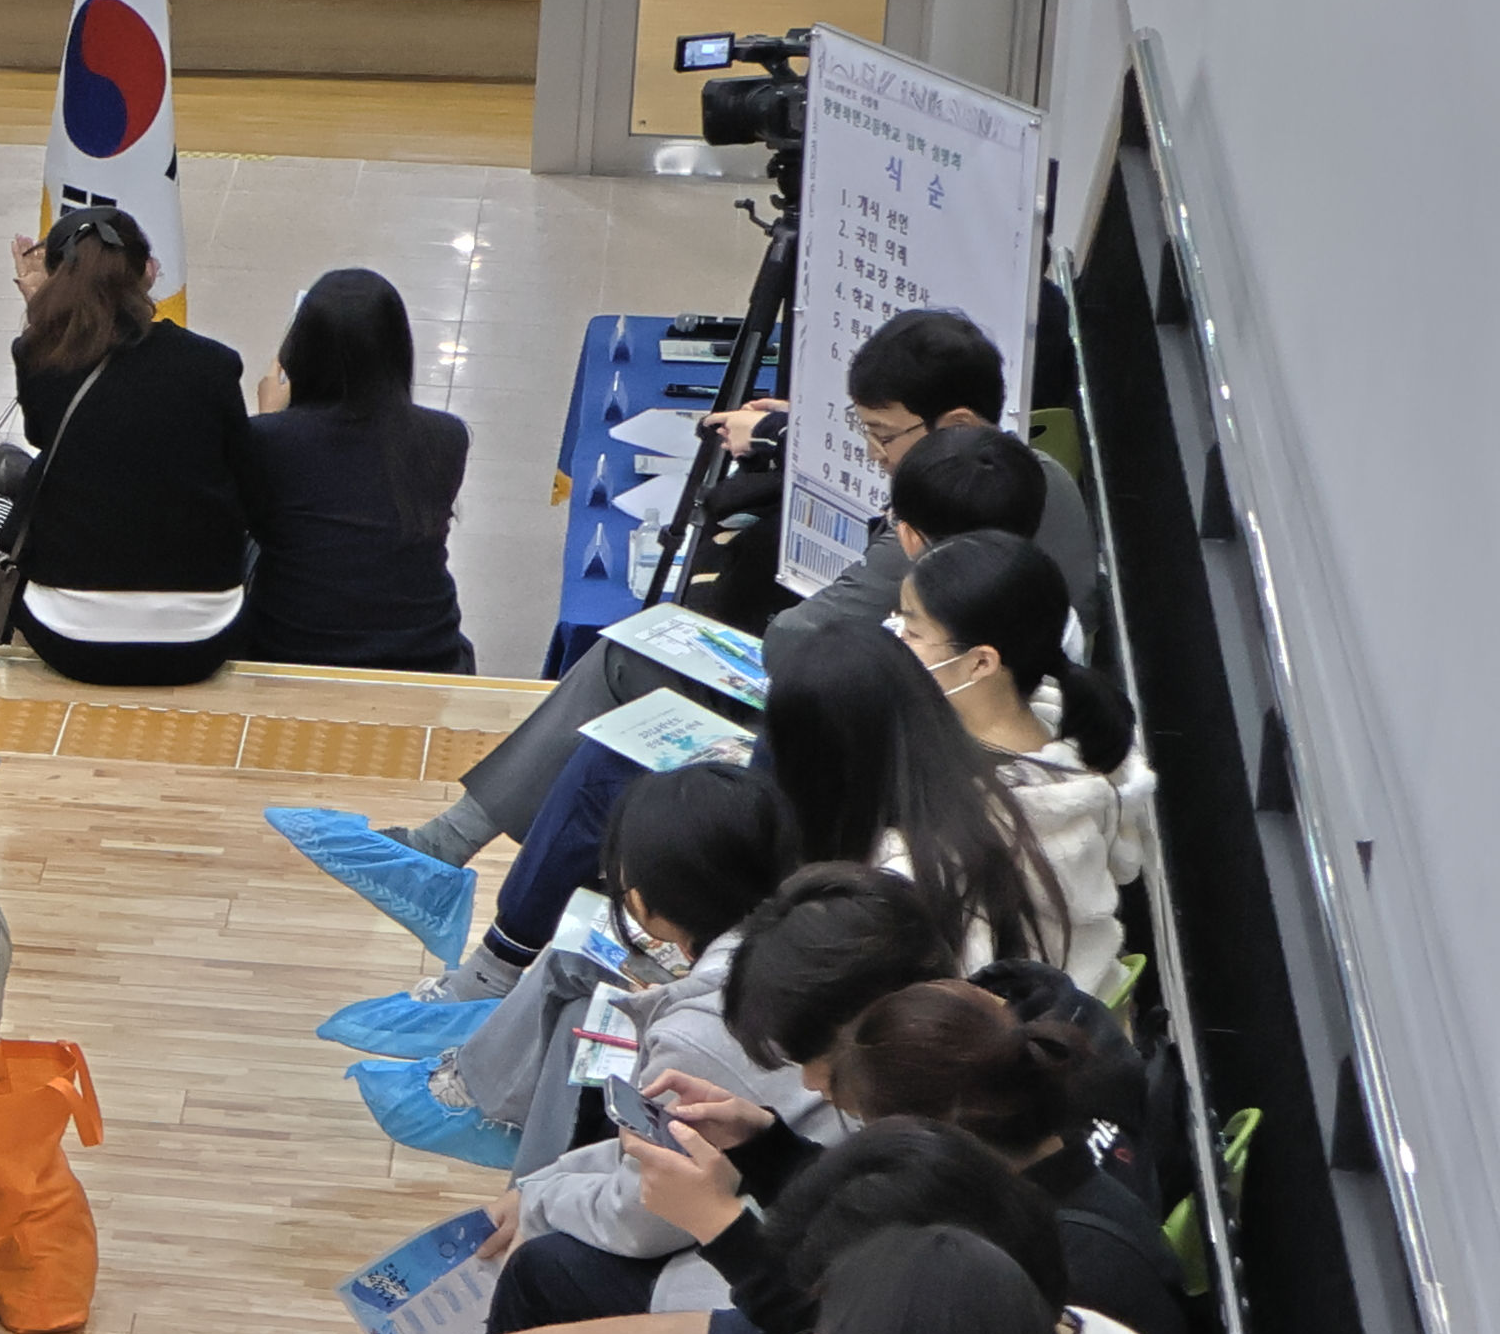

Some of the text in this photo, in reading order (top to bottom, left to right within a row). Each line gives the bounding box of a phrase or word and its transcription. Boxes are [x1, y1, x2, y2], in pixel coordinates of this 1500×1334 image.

[885, 155, 945, 210] 식 순
[841, 188, 909, 236] 1. 개식 선언
[838, 219, 907, 267] 2. 국민 의례
[837, 249, 930, 308] 3. 학교장 환영사
[835, 281, 846, 301] 4.
[852, 286, 875, 313] 학교
[833, 311, 843, 331] 5.
[831, 342, 842, 362] 6.
[828, 402, 838, 423] 7.
[825, 432, 836, 453] 8.
[822, 462, 833, 483] 9.
[839, 470, 862, 498] 폐식
